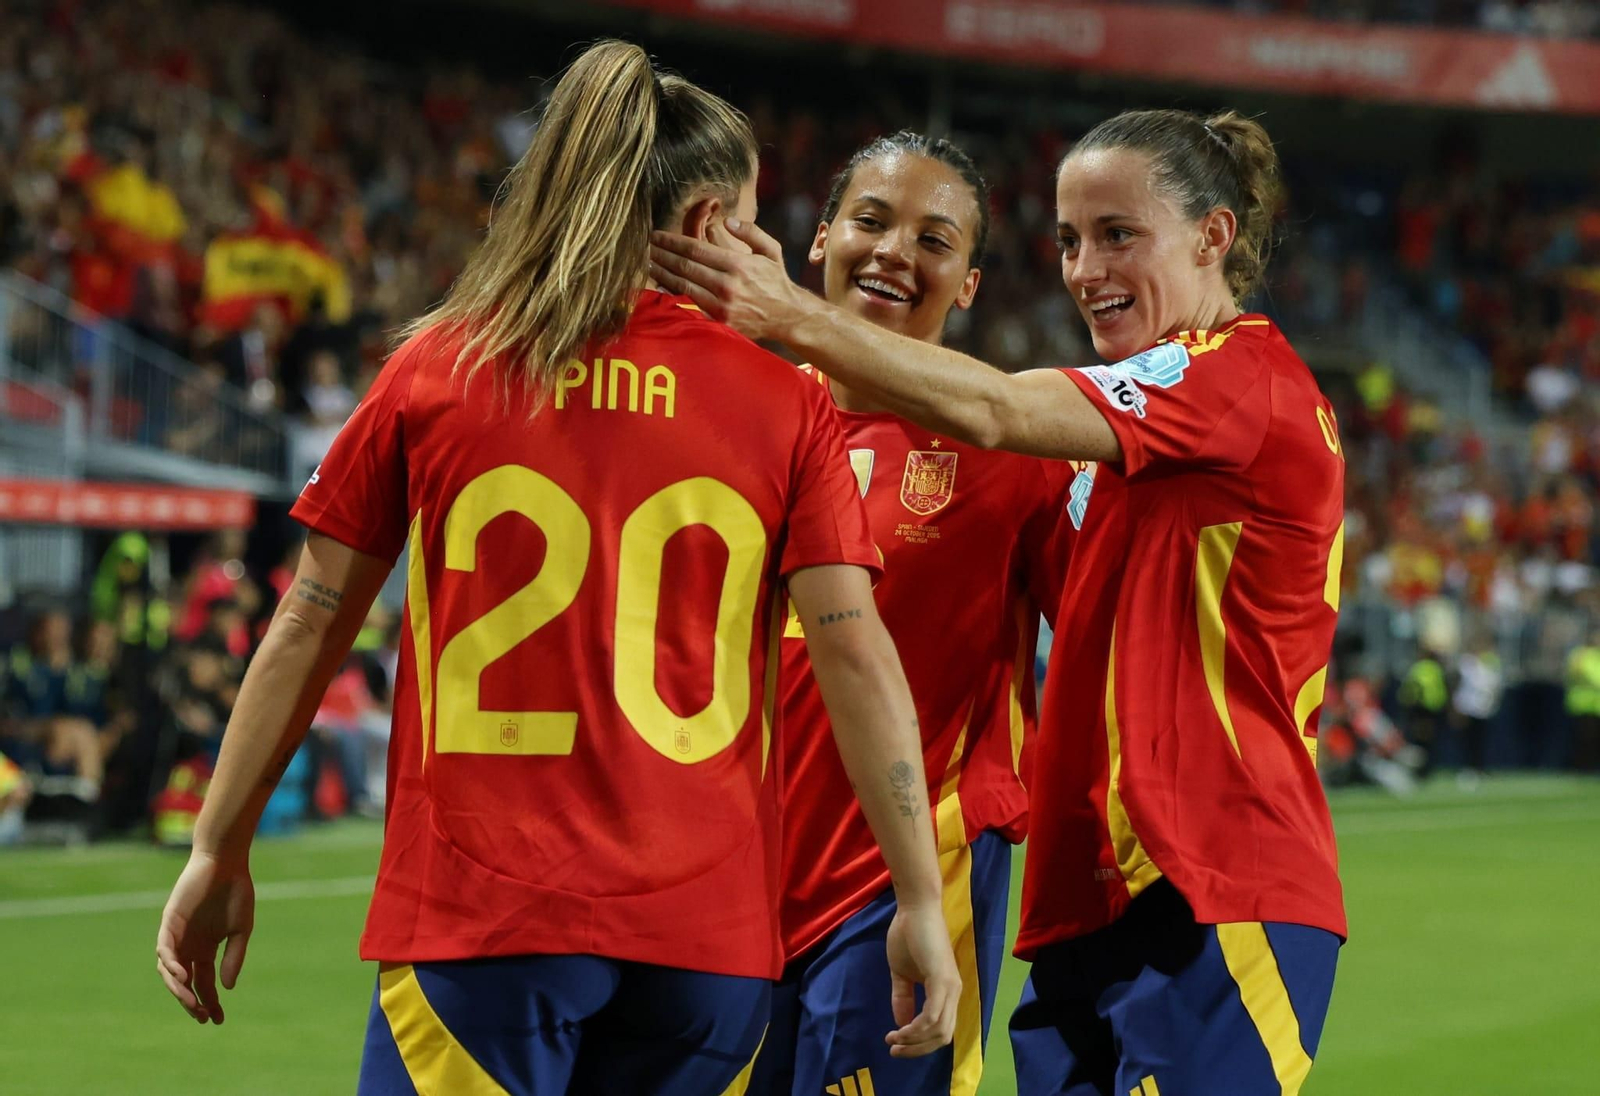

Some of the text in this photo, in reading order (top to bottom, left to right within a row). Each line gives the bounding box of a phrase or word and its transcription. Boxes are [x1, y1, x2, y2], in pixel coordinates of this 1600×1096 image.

[555, 357, 676, 418] PINA
[1112, 380, 1137, 406] 10
[435, 464, 766, 764] 20
[818, 608, 863, 626] BRAVE
